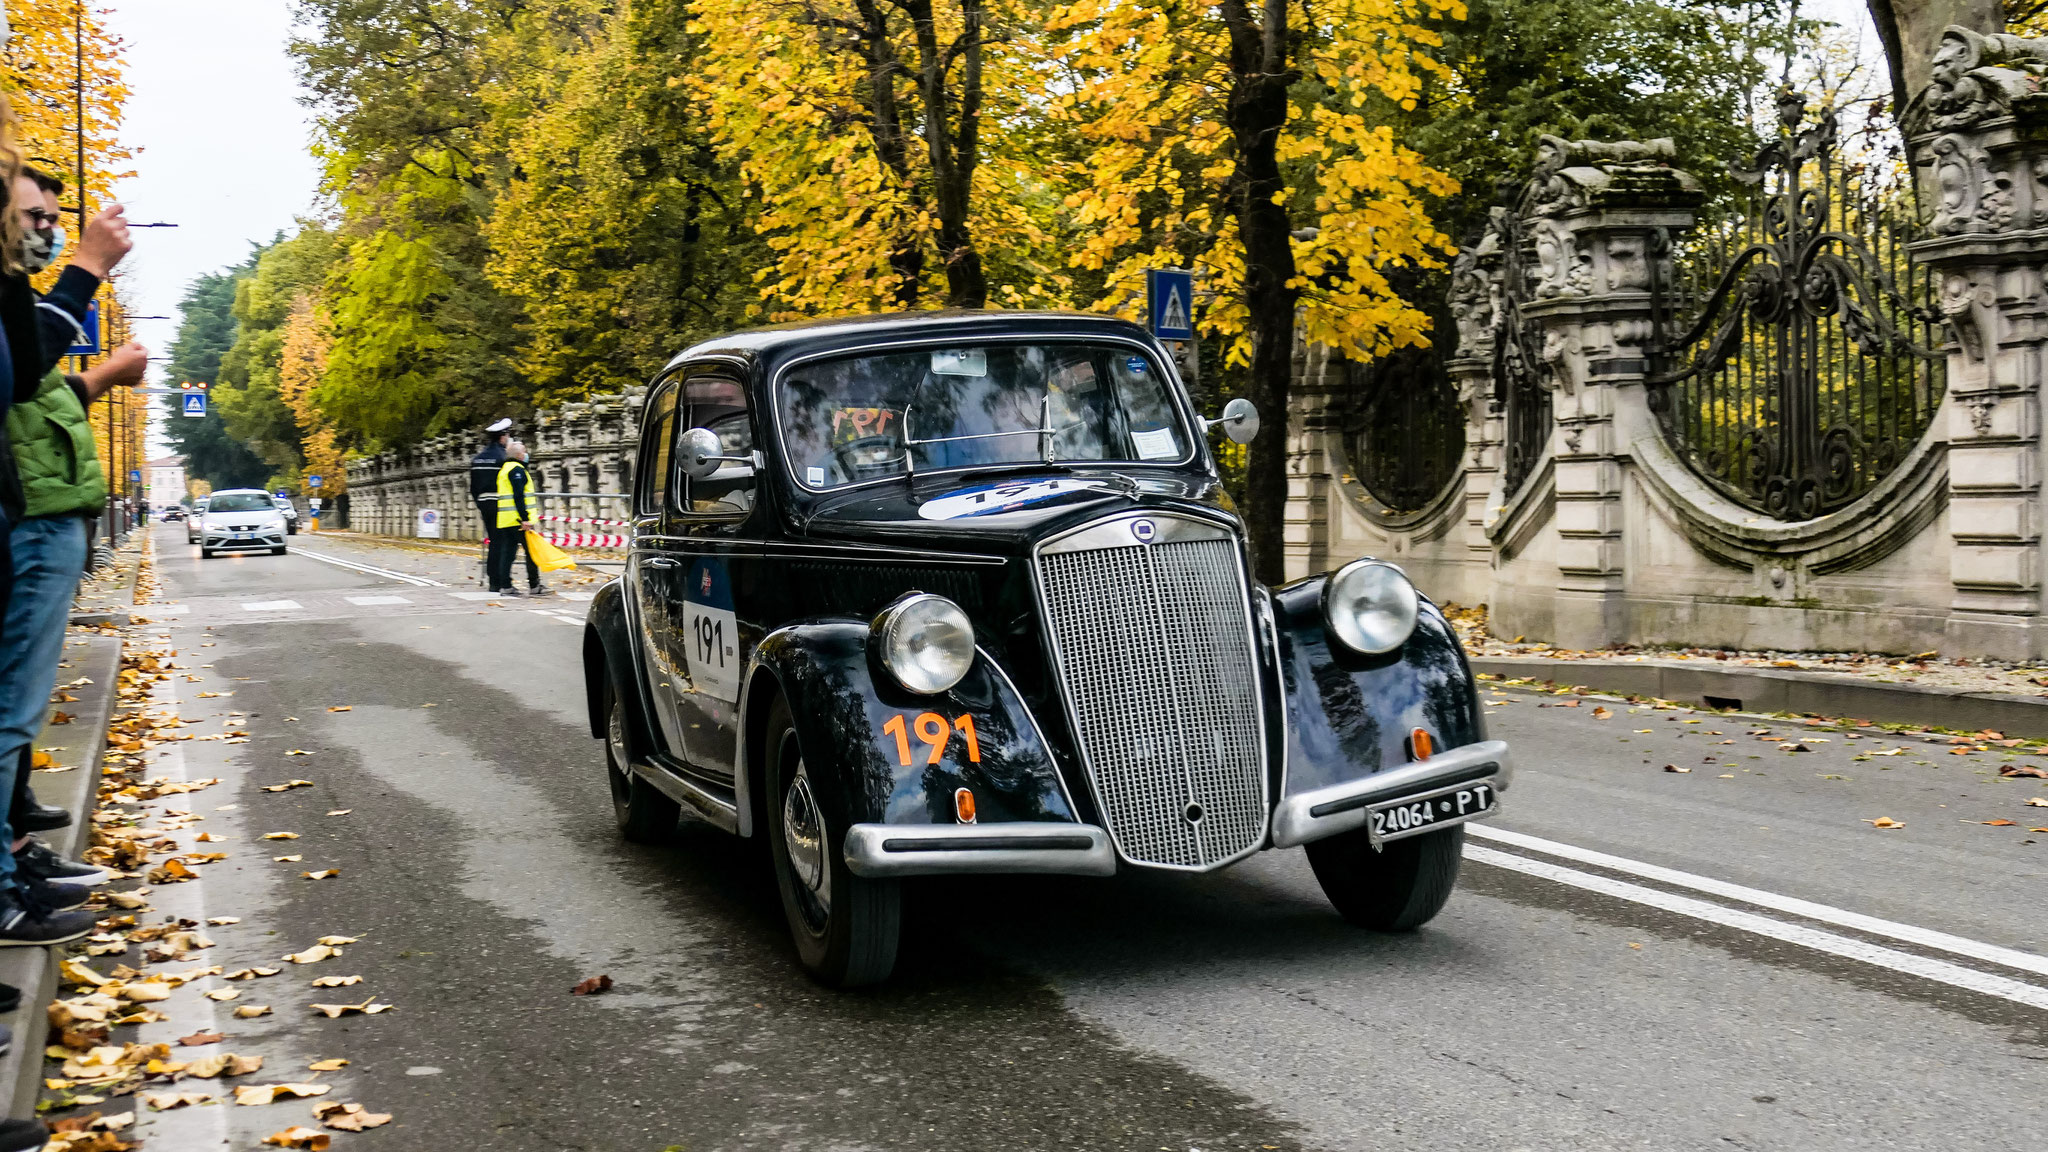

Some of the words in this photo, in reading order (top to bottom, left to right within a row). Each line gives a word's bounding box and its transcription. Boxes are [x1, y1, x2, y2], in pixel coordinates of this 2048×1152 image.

[965, 480, 1059, 504] 191
[694, 614, 724, 668] 191
[883, 712, 981, 766] 191
[1374, 801, 1435, 834] 24064
[1456, 785, 1489, 815] PT
